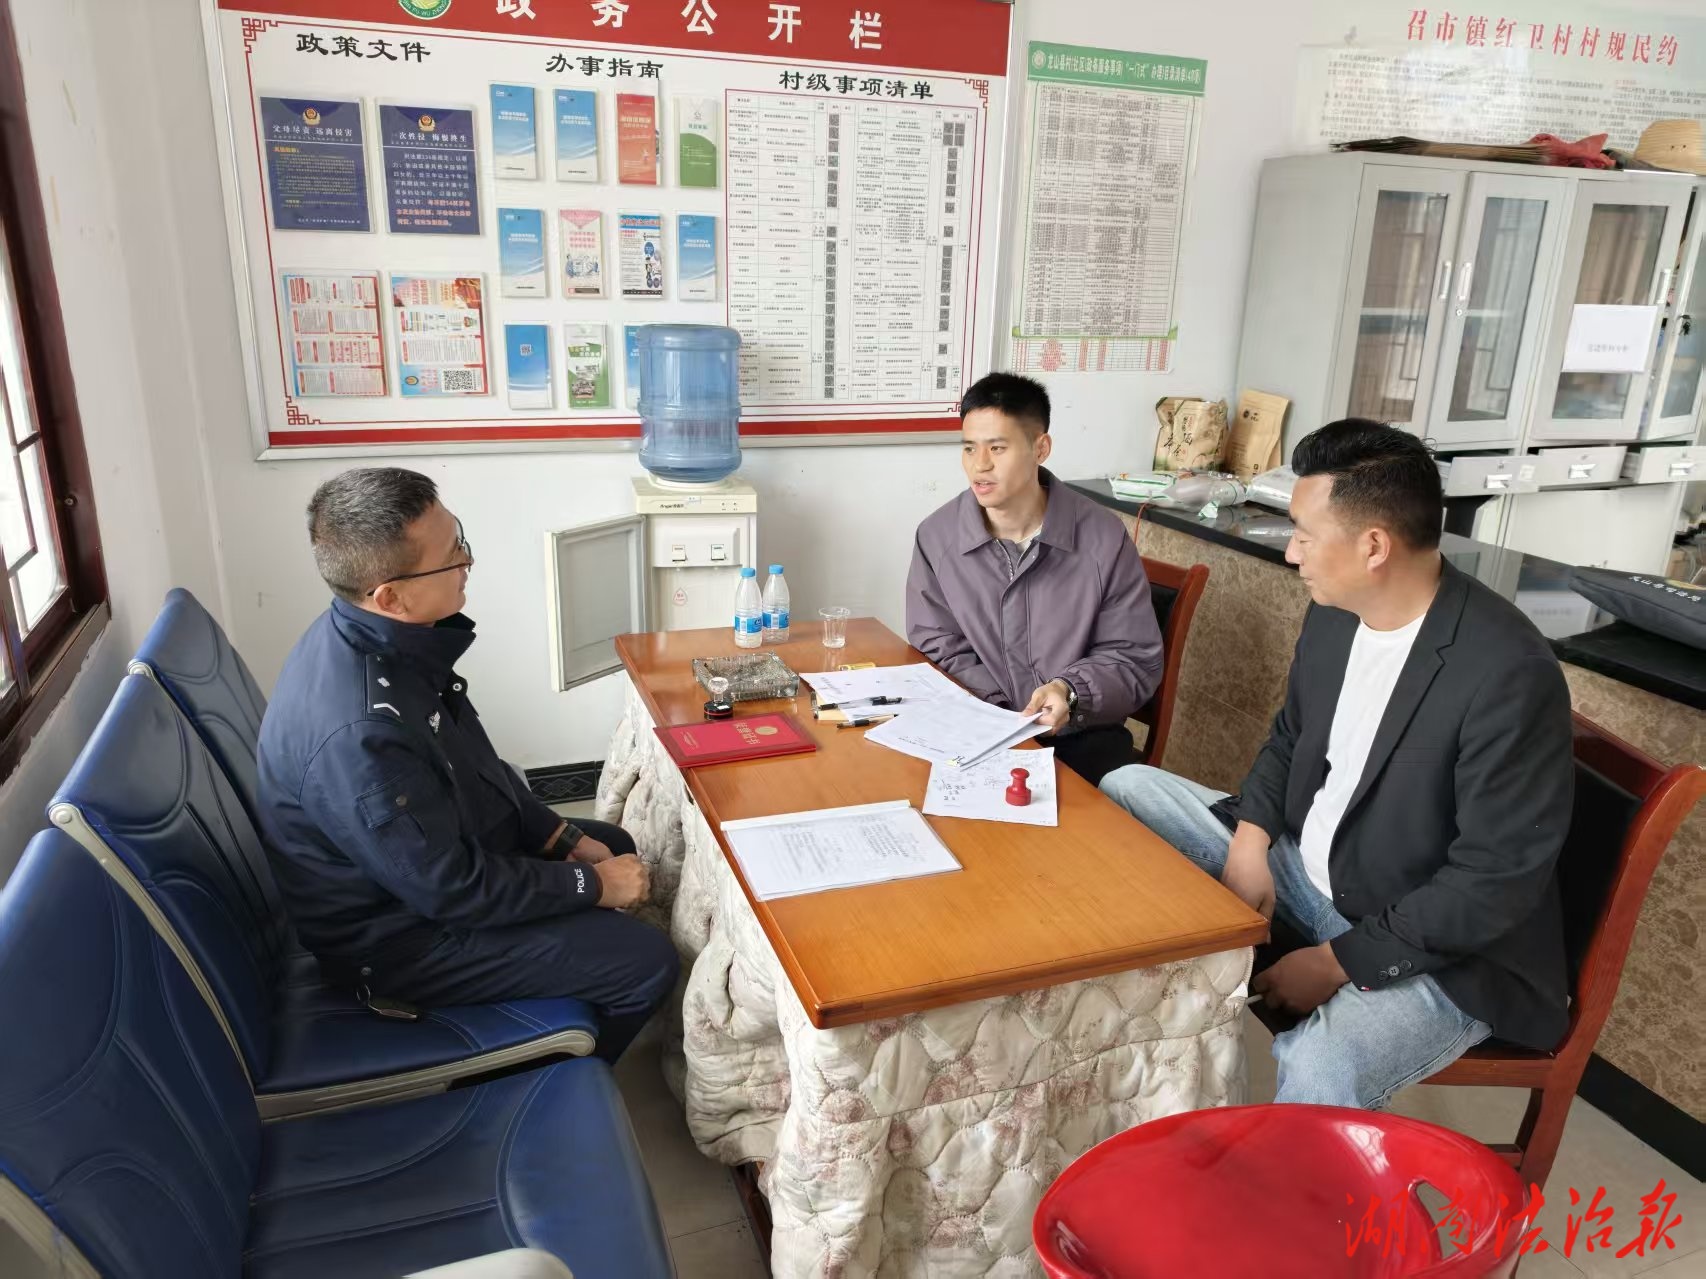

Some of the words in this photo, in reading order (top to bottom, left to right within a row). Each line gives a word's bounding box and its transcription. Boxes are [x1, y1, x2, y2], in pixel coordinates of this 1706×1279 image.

[295, 33, 431, 63] 政策文件
[1406, 8, 1679, 66] 召市镇红卫村村规民约
[545, 53, 664, 80] 办事指南
[778, 71, 935, 99] 村级事项清单
[574, 868, 585, 893] POLICE
